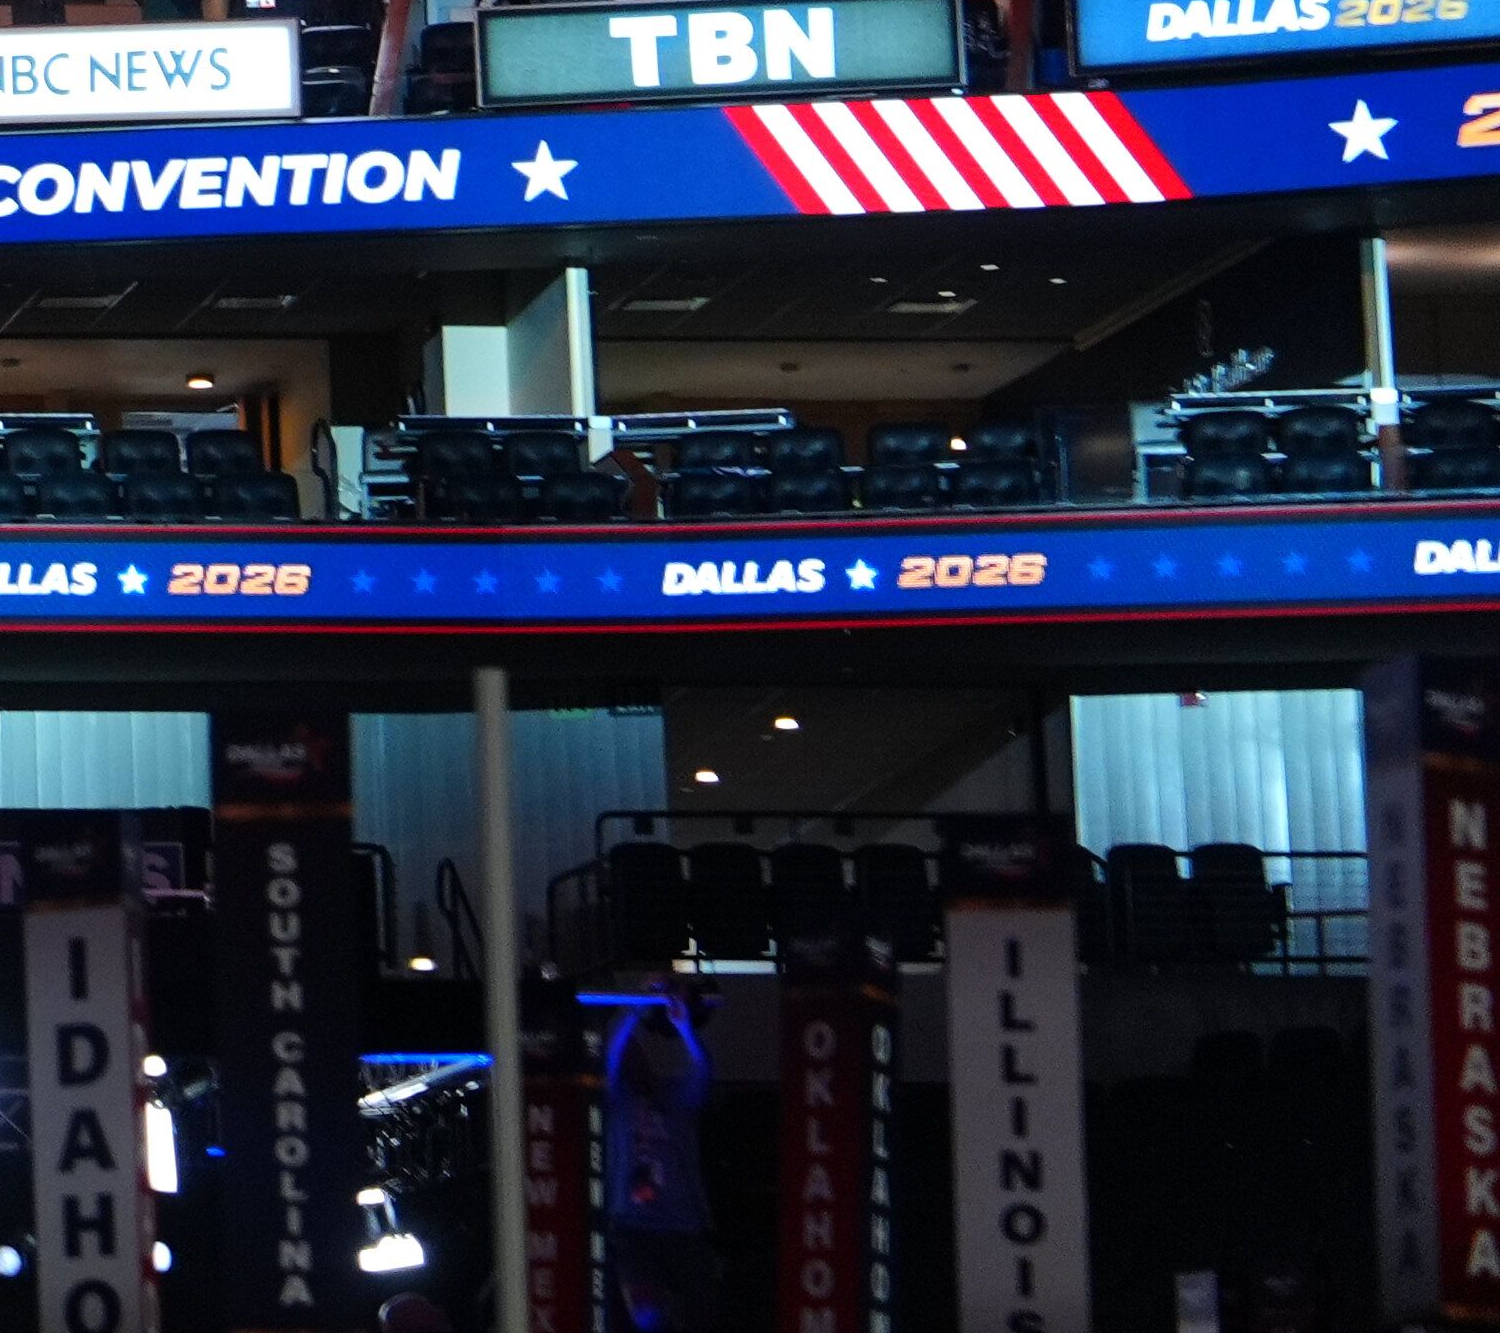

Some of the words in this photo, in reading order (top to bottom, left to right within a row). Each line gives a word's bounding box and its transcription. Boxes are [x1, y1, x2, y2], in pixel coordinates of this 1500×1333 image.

[89, 47, 232, 91] NEWS
[609, 7, 835, 87] TBN
[168, 564, 311, 594] 2026
[663, 559, 825, 595] DALLAS
[897, 554, 1047, 588] 2026
[266, 842, 304, 1012] SOUTH
[1447, 798, 1500, 1281] NEBRASKA
[56, 936, 121, 1333] IDAHO
[272, 1032, 313, 1307] CAROLINA
